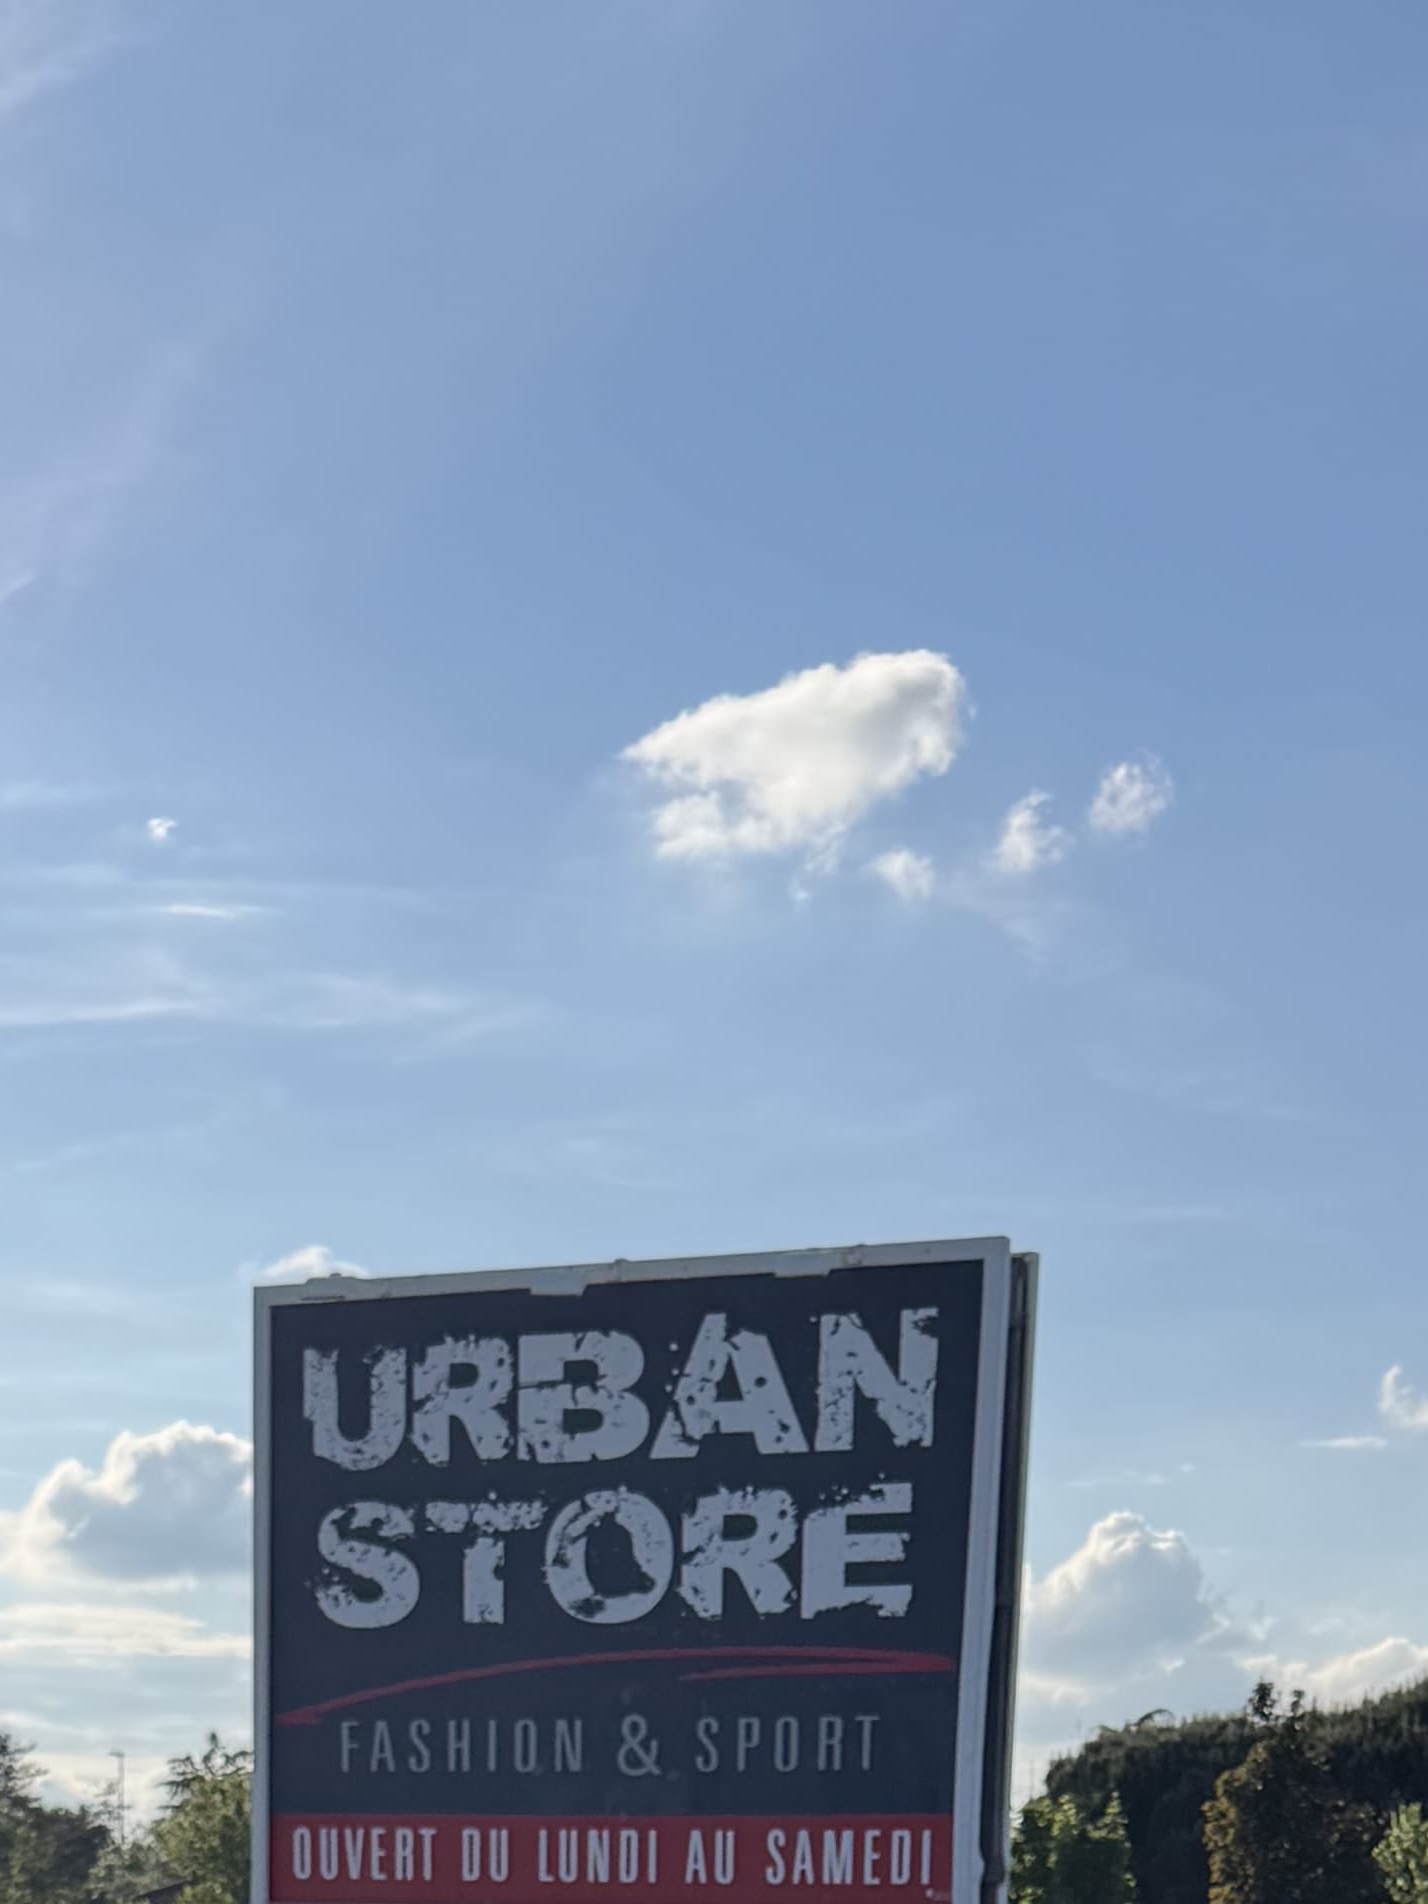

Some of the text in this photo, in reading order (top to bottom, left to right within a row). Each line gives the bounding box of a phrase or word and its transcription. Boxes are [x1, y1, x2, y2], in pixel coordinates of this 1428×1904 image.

[303, 1306, 940, 1471] URBAN
[312, 1480, 914, 1629] STORE
[340, 1714, 882, 1777] FASHION & SPORT
[292, 1827, 932, 1886] OUVERT DU LUNDI AU SAMEDI
